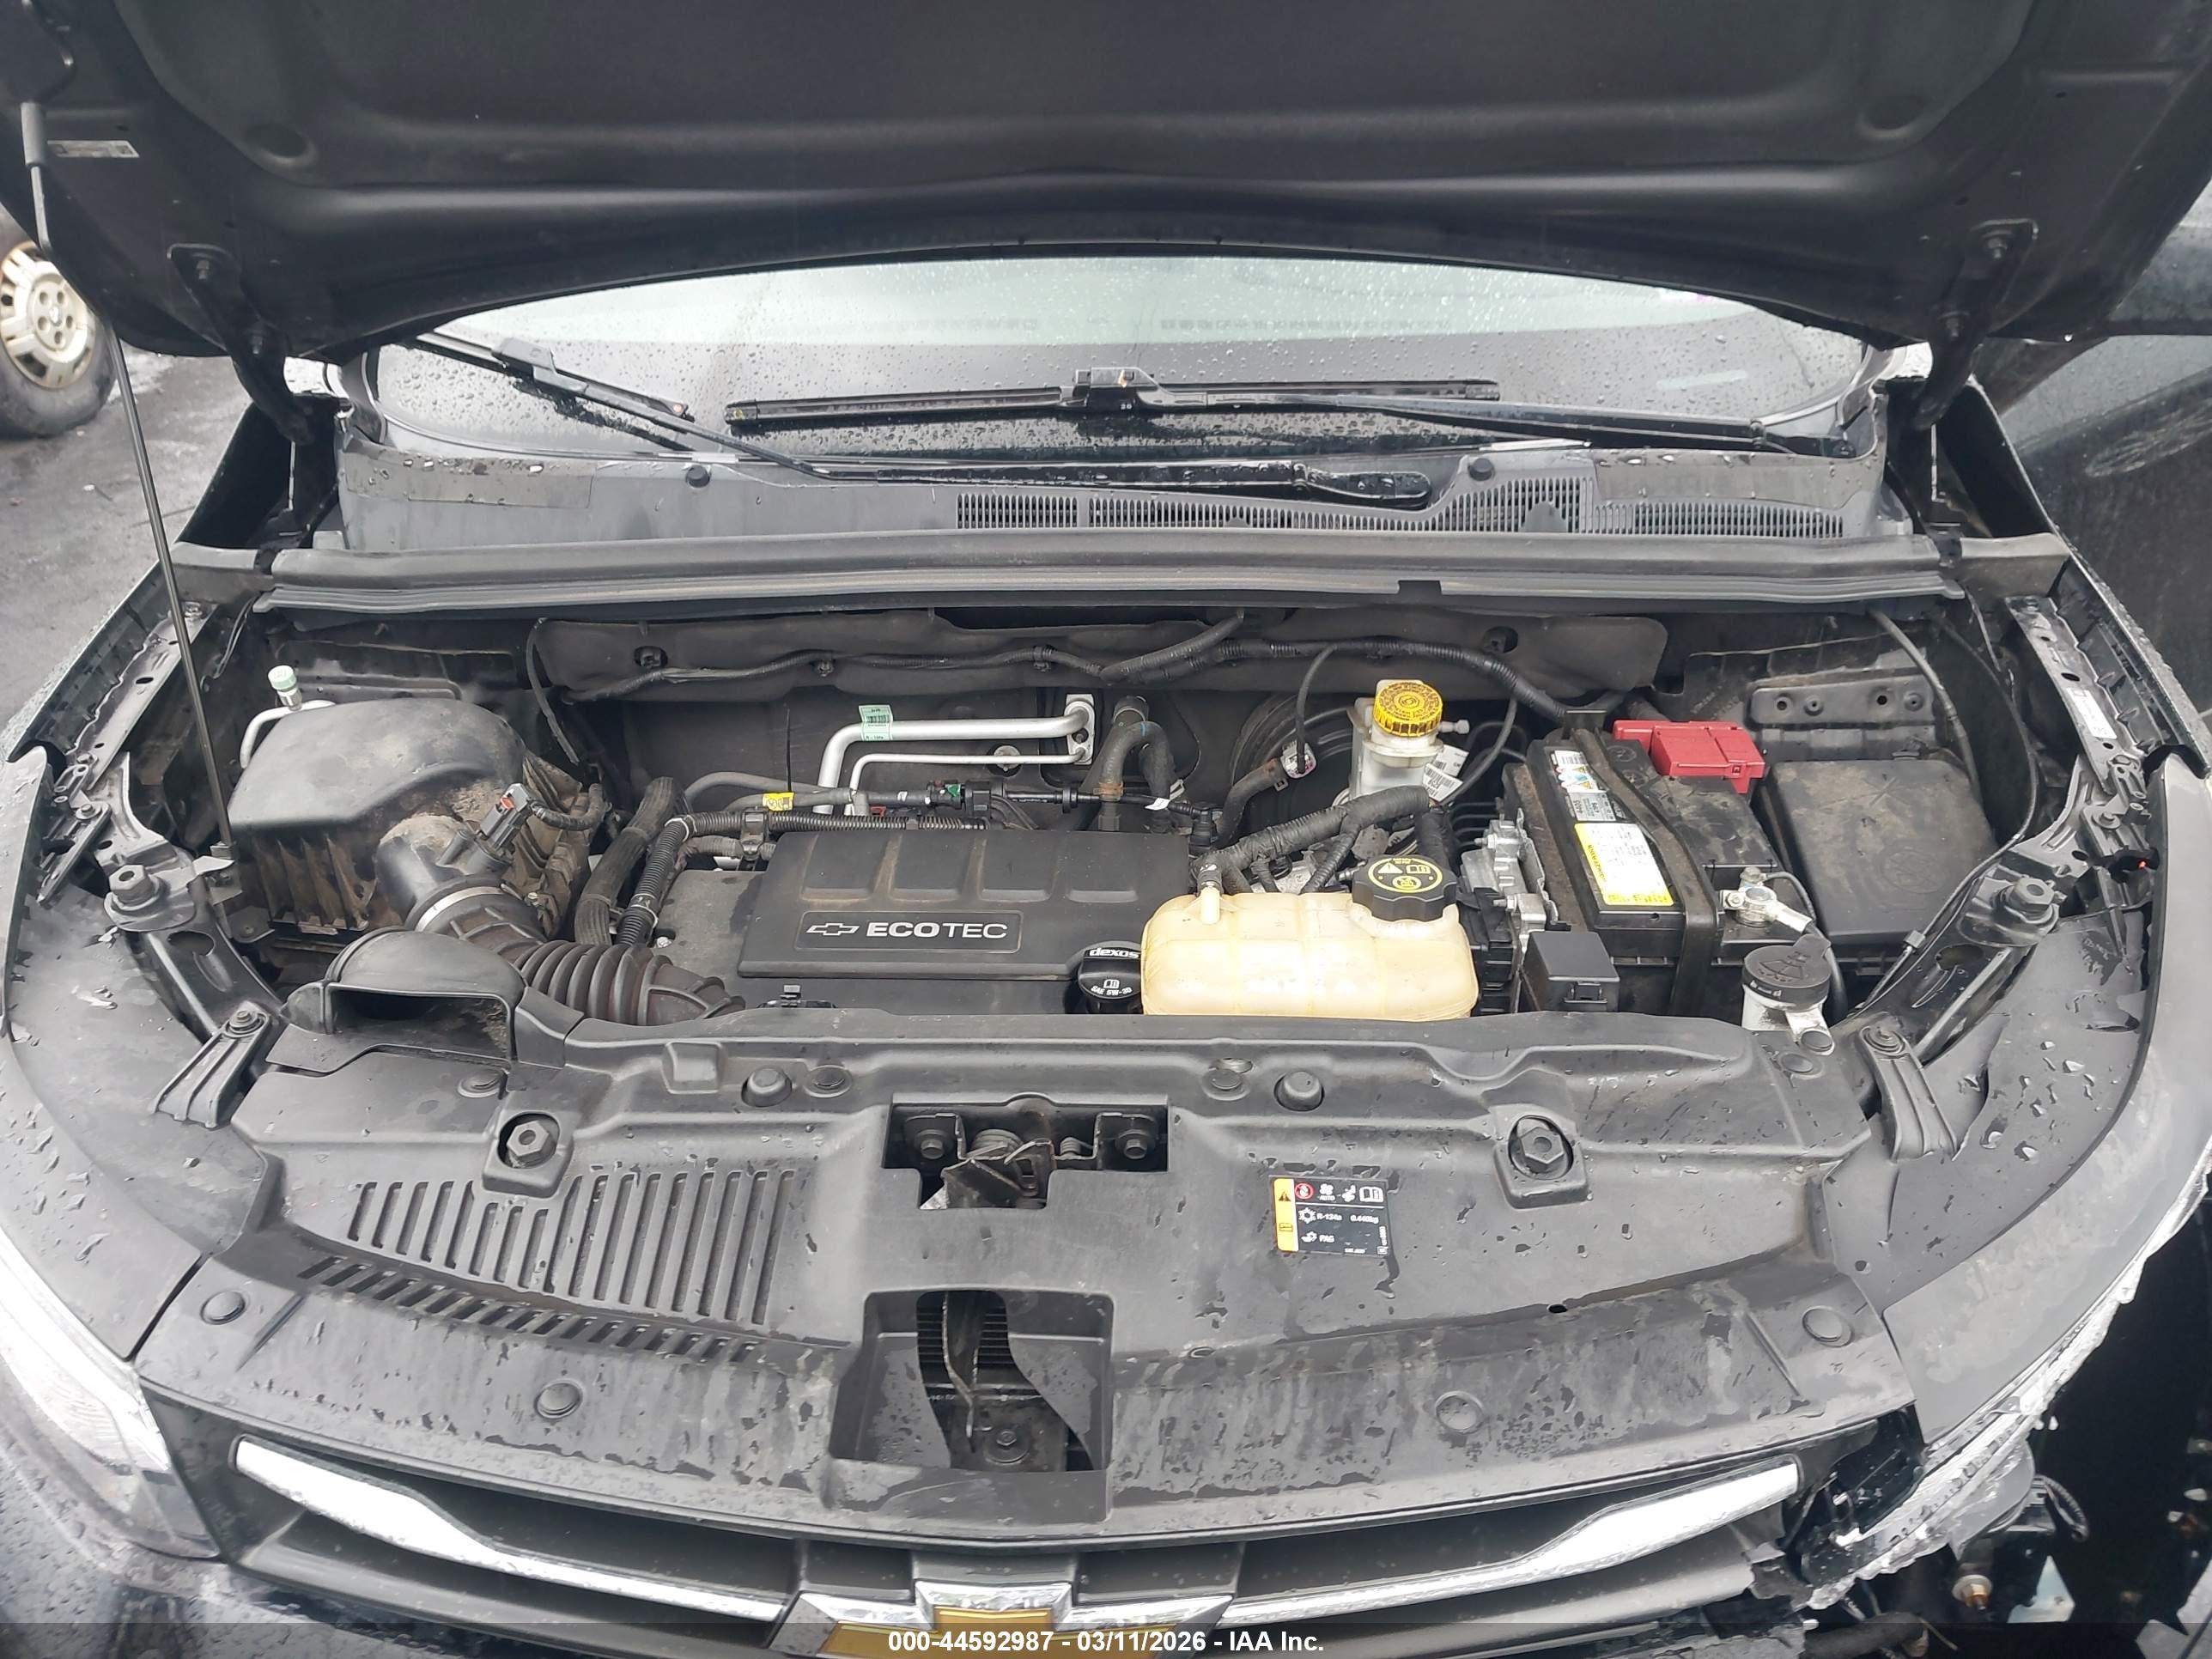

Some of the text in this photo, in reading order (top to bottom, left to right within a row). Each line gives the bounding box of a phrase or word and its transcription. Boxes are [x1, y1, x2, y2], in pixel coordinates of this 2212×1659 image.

[866, 921, 1008, 939] ECOTEC
[1090, 948, 1139, 958] dexos
[1091, 986, 1132, 995] SAE 5W-30
